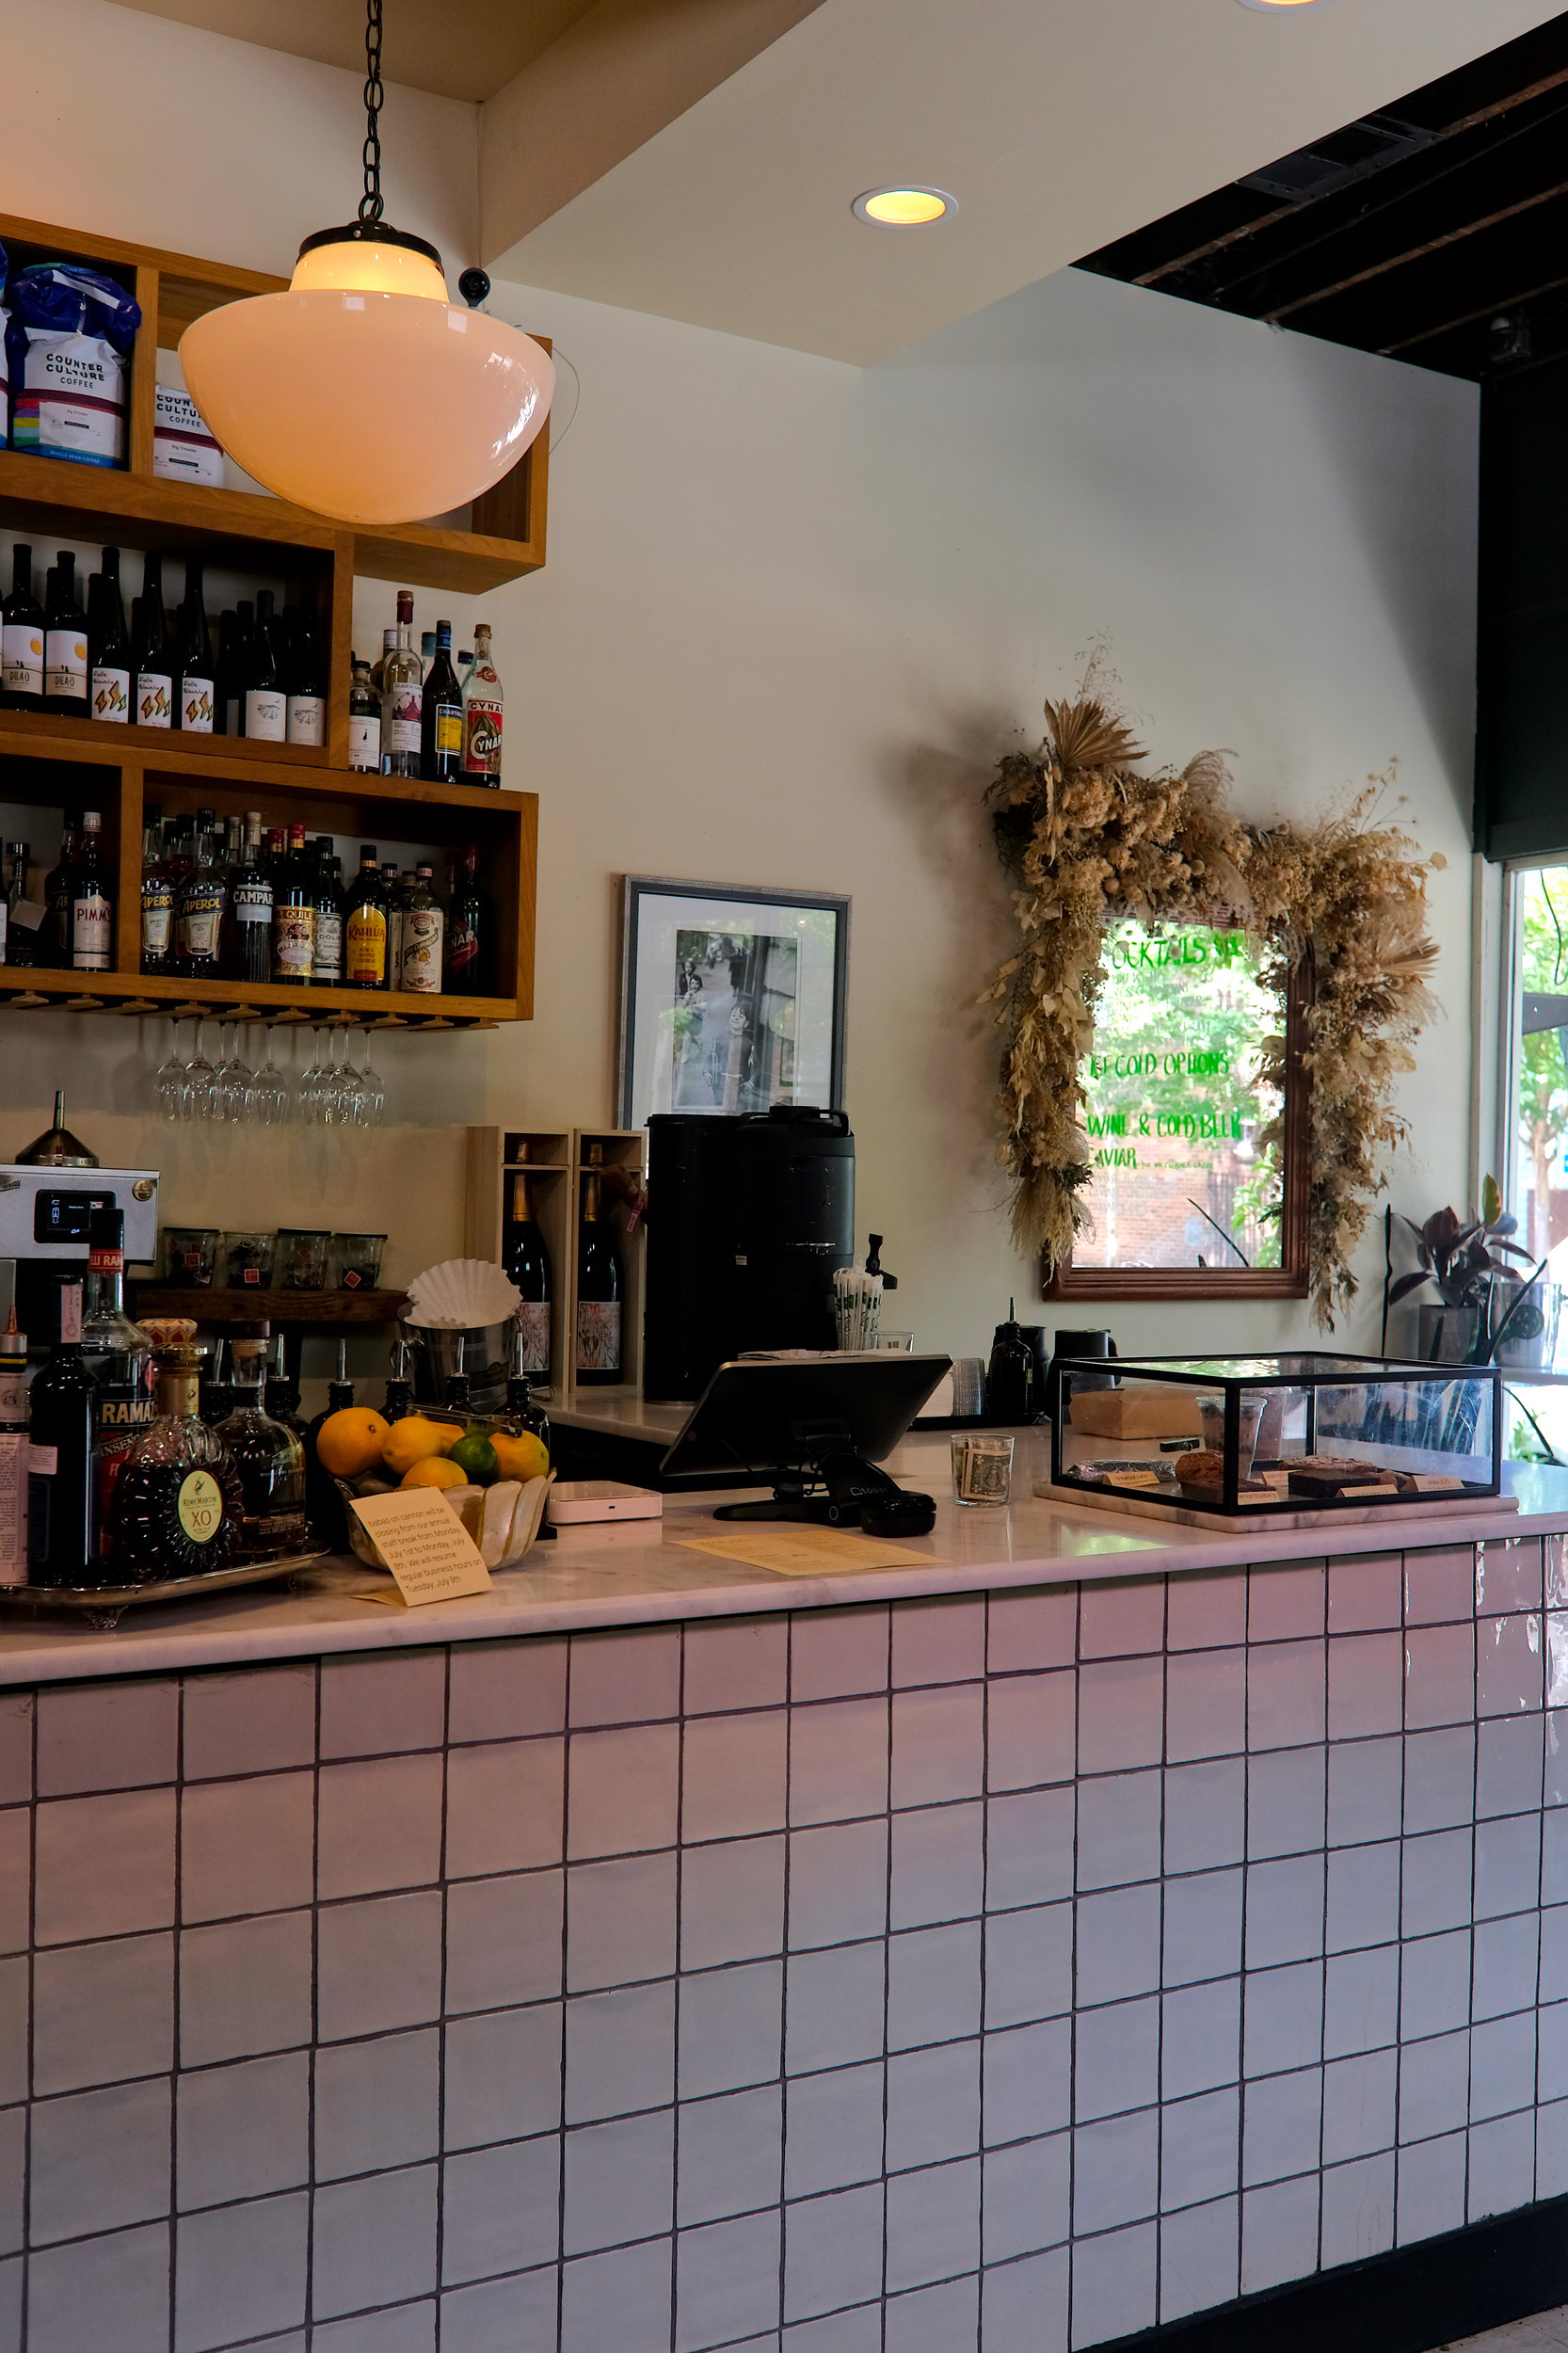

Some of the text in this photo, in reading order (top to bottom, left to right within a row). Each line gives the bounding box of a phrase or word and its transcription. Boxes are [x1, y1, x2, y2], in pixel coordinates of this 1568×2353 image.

[45, 363, 105, 381] CULTURE
[46, 354, 104, 373] COUNTER
[60, 376, 94, 389] COFFEE
[156, 394, 196, 408] COUN
[156, 403, 201, 418] CULTU
[169, 416, 201, 427] COFFEE
[183, 897, 221, 914] APEROL
[77, 907, 111, 922] PIMM'S
[1112, 935, 1206, 969] OCKTAILS
[1115, 1053, 1158, 1078] COLD
[1163, 1051, 1229, 1077] OPTIONS
[1087, 1114, 1127, 1137] WINE
[1139, 1112, 1151, 1137] &
[1157, 1113, 1196, 1139] COLD
[1095, 1147, 1137, 1170] AVIAR
[191, 1510, 211, 1527] XO
[375, 1528, 401, 1538] closing
[397, 1536, 416, 1545] break
[389, 1551, 403, 1560] July
[452, 1538, 465, 1546] July
[408, 1559, 420, 1567] We
[432, 1551, 457, 1561] resume
[400, 1572, 424, 1582] regular
[424, 1565, 454, 1576] business
[454, 1561, 472, 1569] hours
[437, 1577, 450, 1587] July
